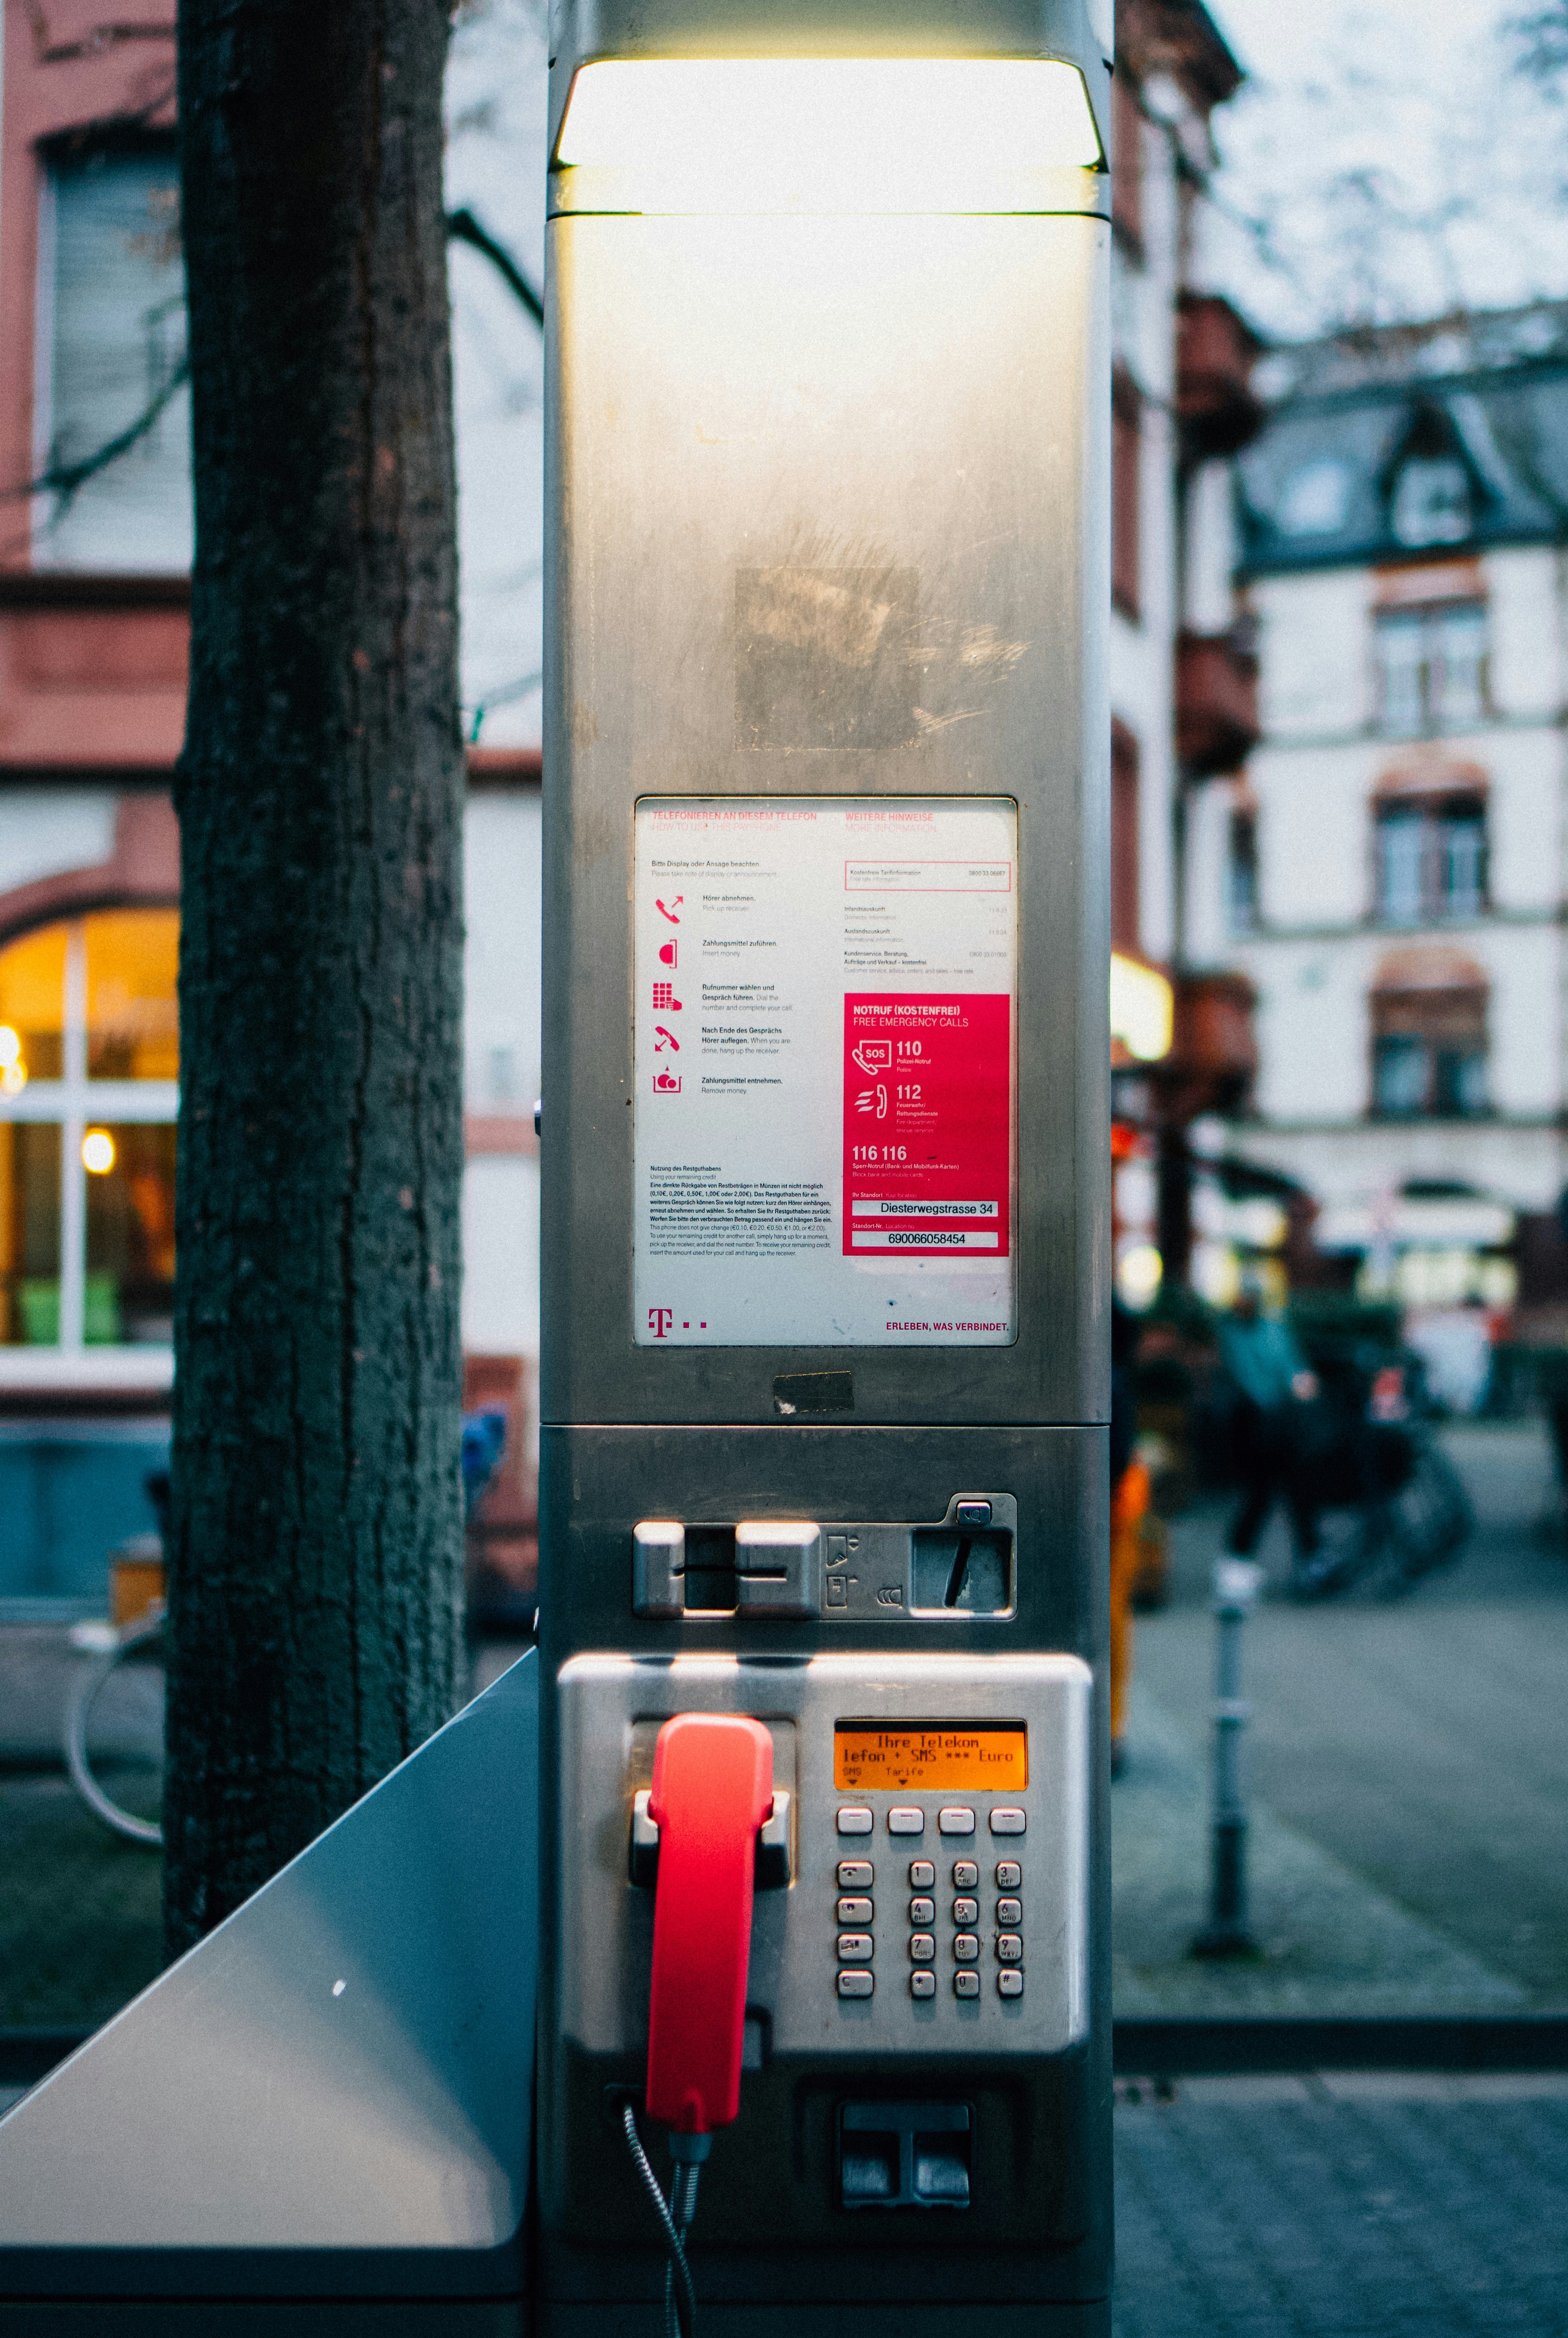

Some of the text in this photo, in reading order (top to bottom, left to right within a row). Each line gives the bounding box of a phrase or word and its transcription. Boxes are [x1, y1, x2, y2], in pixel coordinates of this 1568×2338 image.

[854, 1005, 960, 1015] NOTRUF (KOSTENFREI)
[854, 1017, 968, 1027] FREE EMERGENCY CALLS
[866, 1049, 885, 1058] SOS
[897, 1041, 922, 1056] 110
[897, 1084, 921, 1099] 112
[853, 1146, 907, 1160] 116 116
[881, 1203, 992, 1215] Diesterwegstrasse 34
[889, 1234, 965, 1243] 690066058454
[878, 1735, 979, 1748] Ihre Telekom
[844, 1750, 1013, 1762] lefon SMS Euro
[843, 1767, 924, 1776] SMS Tarife
[915, 1867, 919, 1877] 1
[958, 1867, 964, 1878] 2
[1001, 1867, 1007, 1877] 3
[914, 1903, 921, 1913] 4
[958, 1904, 964, 1914] 5
[1002, 1904, 1008, 1915] 6
[914, 1939, 921, 1949] 7
[958, 1940, 965, 1950] 8
[1002, 1940, 1008, 1950] 9
